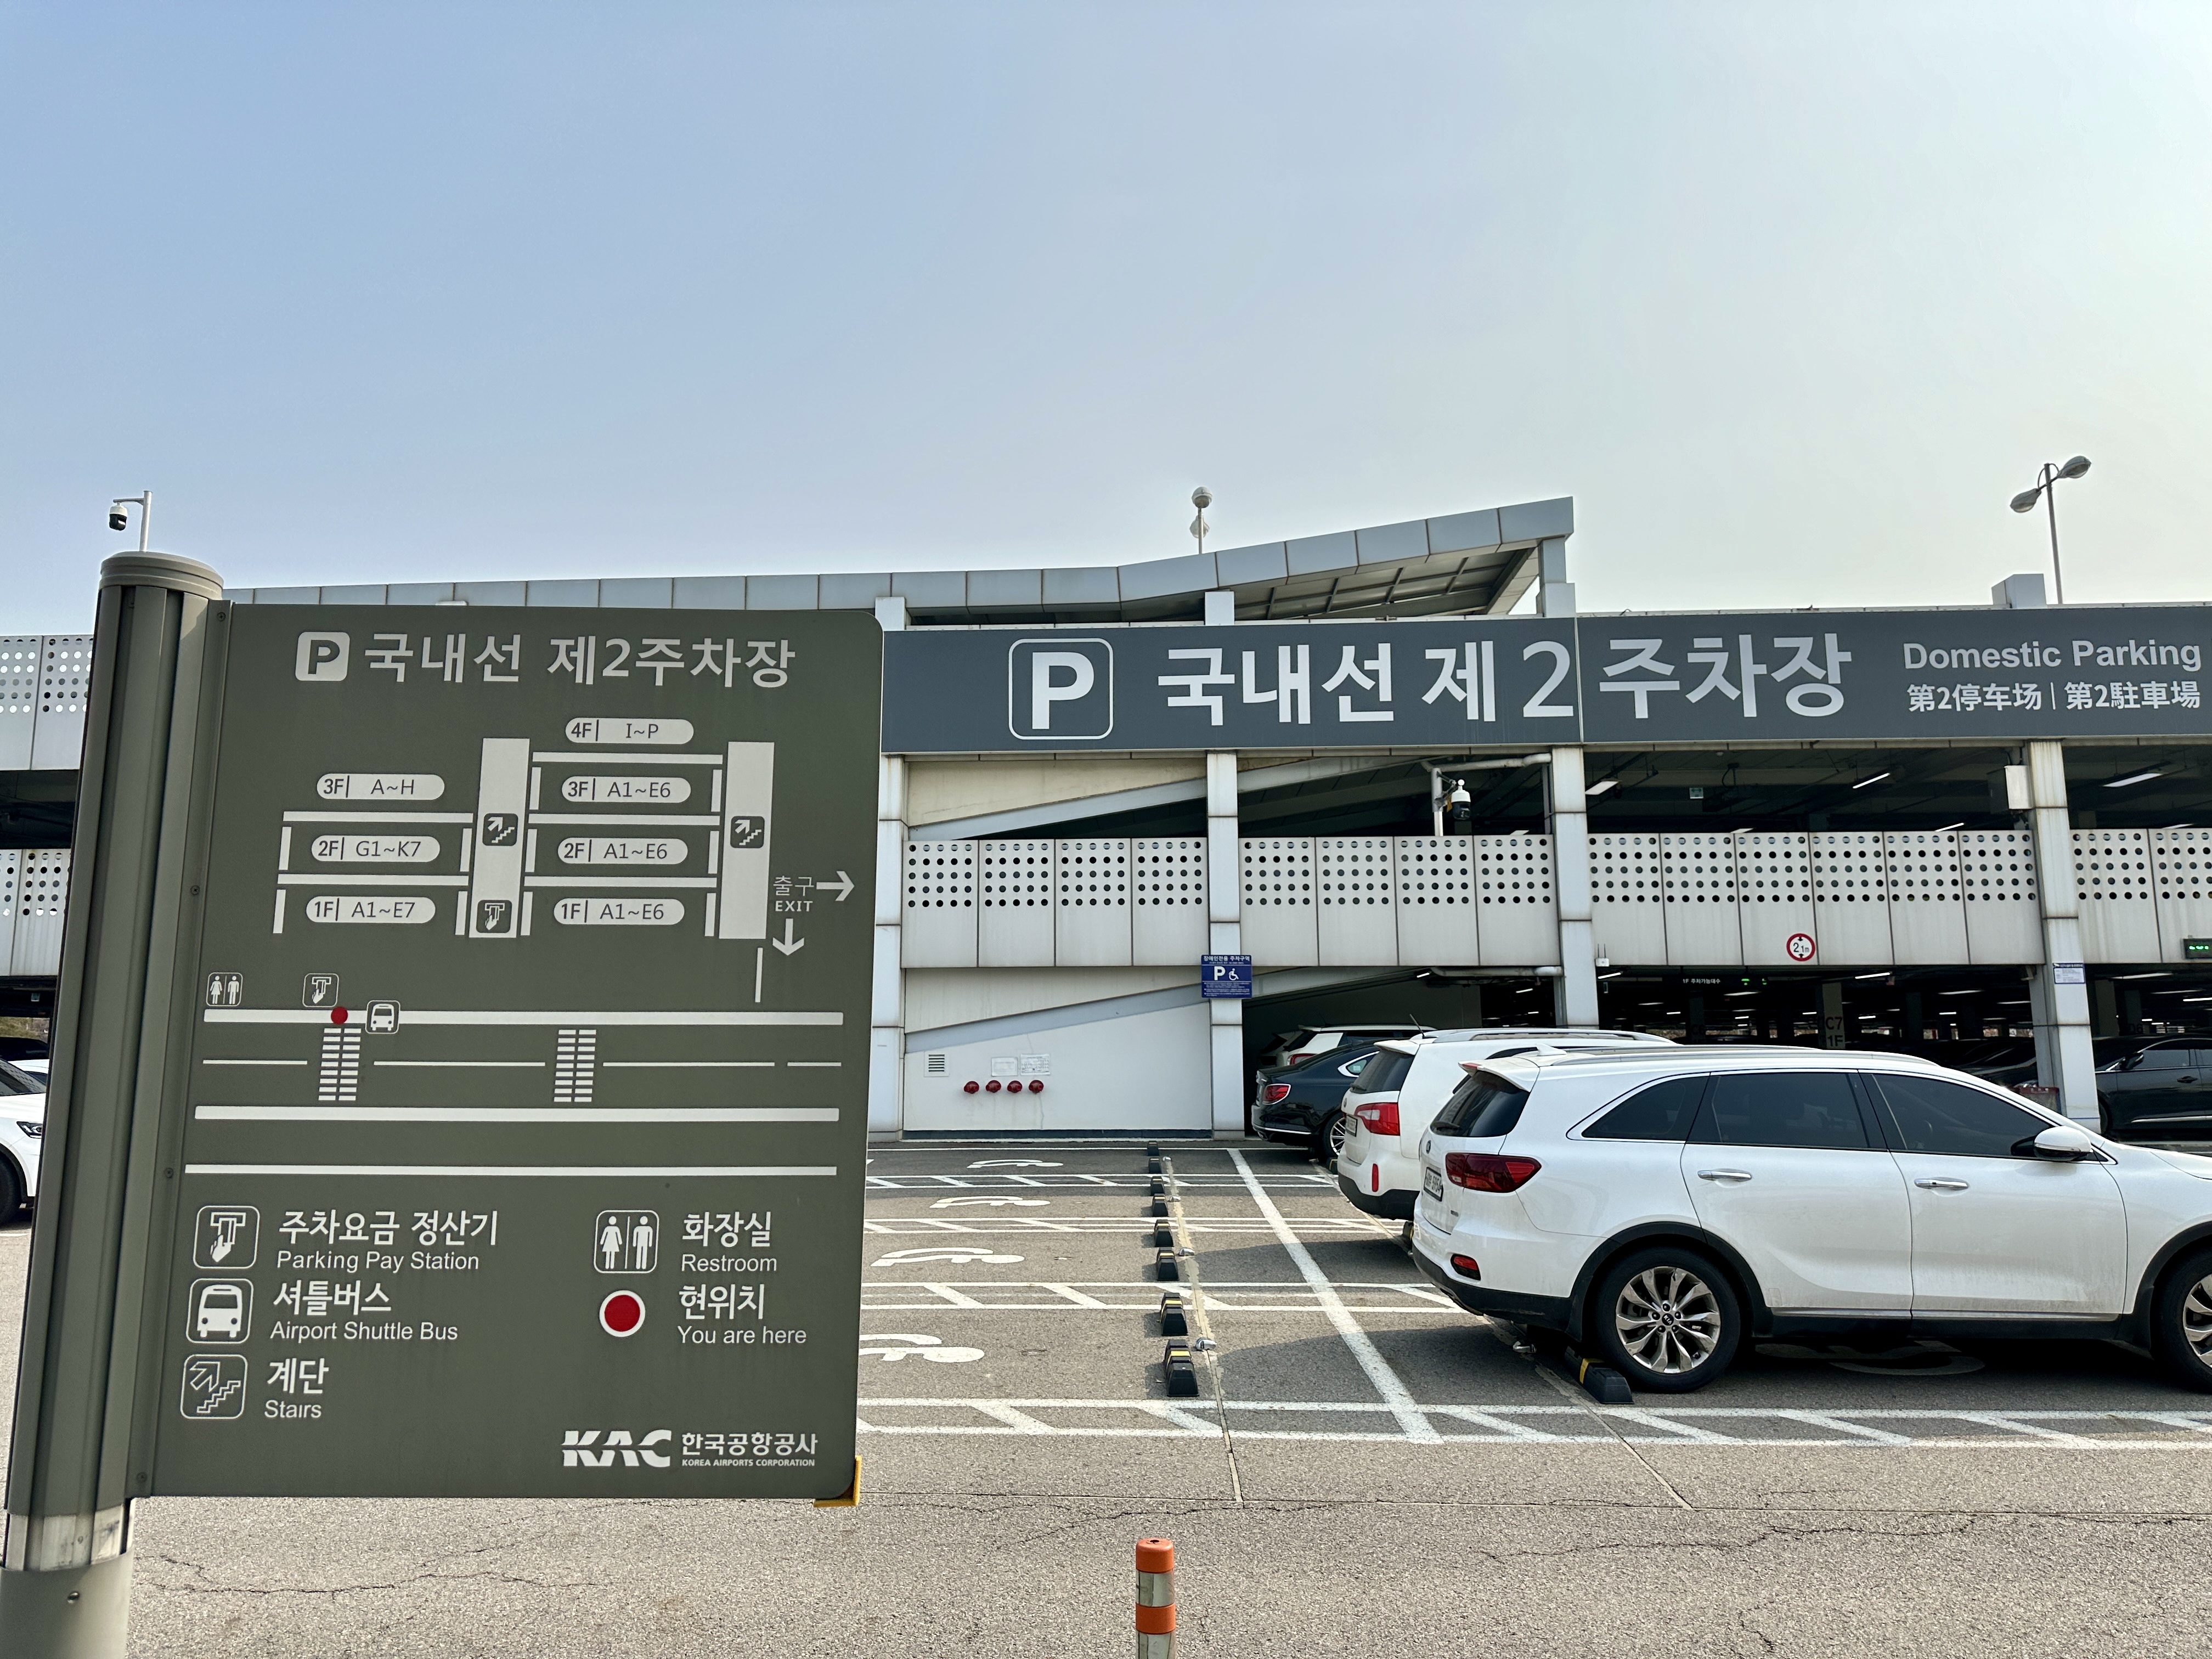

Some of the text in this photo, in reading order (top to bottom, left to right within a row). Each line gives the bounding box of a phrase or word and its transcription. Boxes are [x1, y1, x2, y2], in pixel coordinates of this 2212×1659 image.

[308, 634, 795, 688] P 국내선 제2주차장
[1903, 639, 2202, 672] Domestic Parking
[1032, 652, 1094, 730] P
[1158, 643, 1394, 726] 국내선
[1599, 633, 1852, 719] 주차장
[1906, 681, 2200, 712] 第2停车场 第2駐車場
[571, 722, 592, 738] 4F
[323, 778, 414, 795] 3F A~H
[568, 781, 670, 798] 3F A1~E6
[318, 840, 421, 857] 2F G1~K7
[563, 843, 668, 860] 2F A1~E6
[773, 875, 814, 896] 출구
[314, 901, 415, 918] 1F A1~E7
[561, 903, 664, 920] 1F A1~E6
[775, 900, 813, 912] EXIT
[1214, 966, 1226, 980] P
[1825, 1016, 1843, 1030] C7
[1827, 1035, 1843, 1047] 1F
[279, 1209, 498, 1246] 주차요금 정산기
[682, 1211, 771, 1248] 화장실
[277, 1250, 479, 1274] Parking Pay Station
[681, 1254, 777, 1272] Restroom
[273, 1279, 392, 1316] 셔틀버스
[679, 1284, 765, 1320] 현위치
[270, 1321, 458, 1344] Airport Shuttle Bus
[677, 1325, 806, 1344] You are here
[267, 1358, 329, 1394] 계단
[264, 1400, 321, 1418] Stairs
[561, 1429, 672, 1468] KAC
[682, 1432, 818, 1456] 한국공항공사
